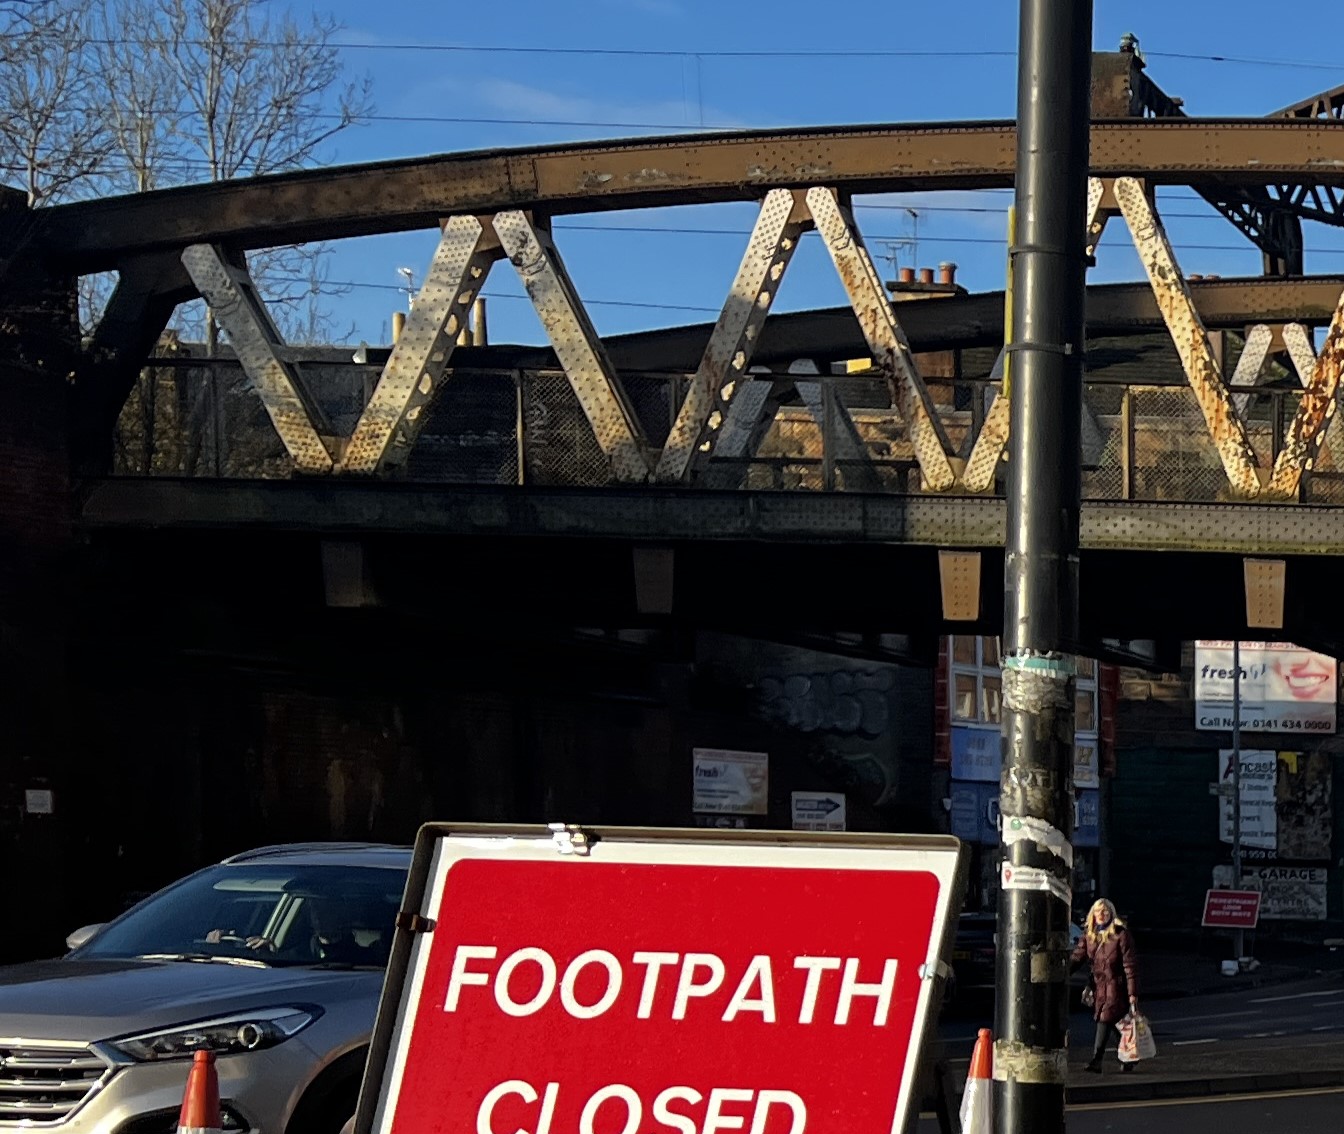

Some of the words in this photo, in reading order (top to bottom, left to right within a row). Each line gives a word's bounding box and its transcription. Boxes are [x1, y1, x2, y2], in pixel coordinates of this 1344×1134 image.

[1200, 717, 1220, 727] Call
[1258, 868, 1316, 880] GARAGE
[443, 945, 898, 1026] FOOTPATH
